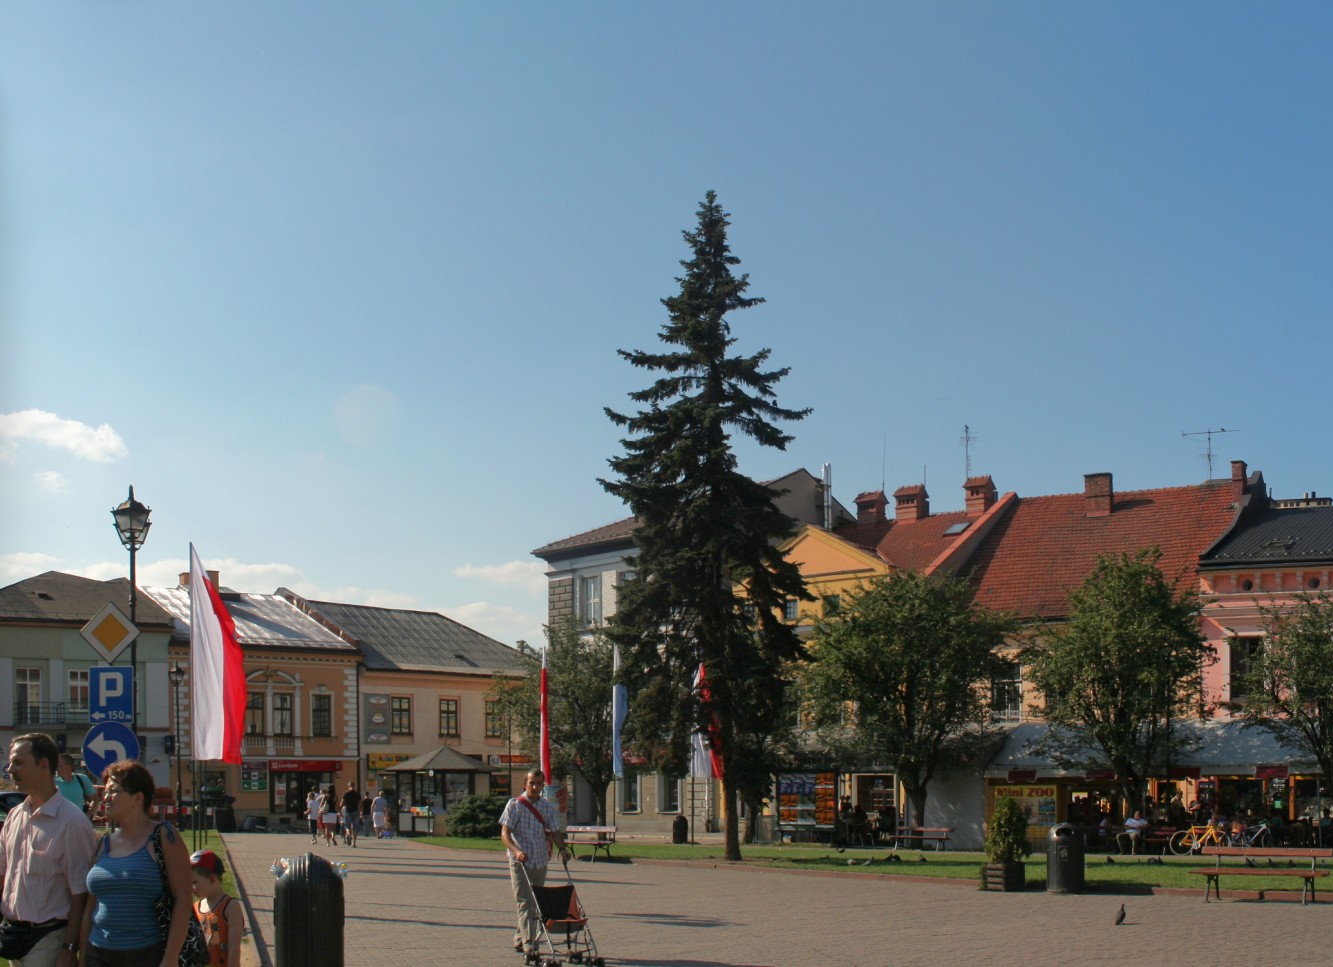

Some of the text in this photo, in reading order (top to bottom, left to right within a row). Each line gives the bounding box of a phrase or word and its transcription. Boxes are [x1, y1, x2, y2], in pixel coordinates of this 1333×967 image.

[99, 672, 124, 707] P
[108, 711, 125, 720] 150
[996, 787, 1055, 798] Mini ZOO
